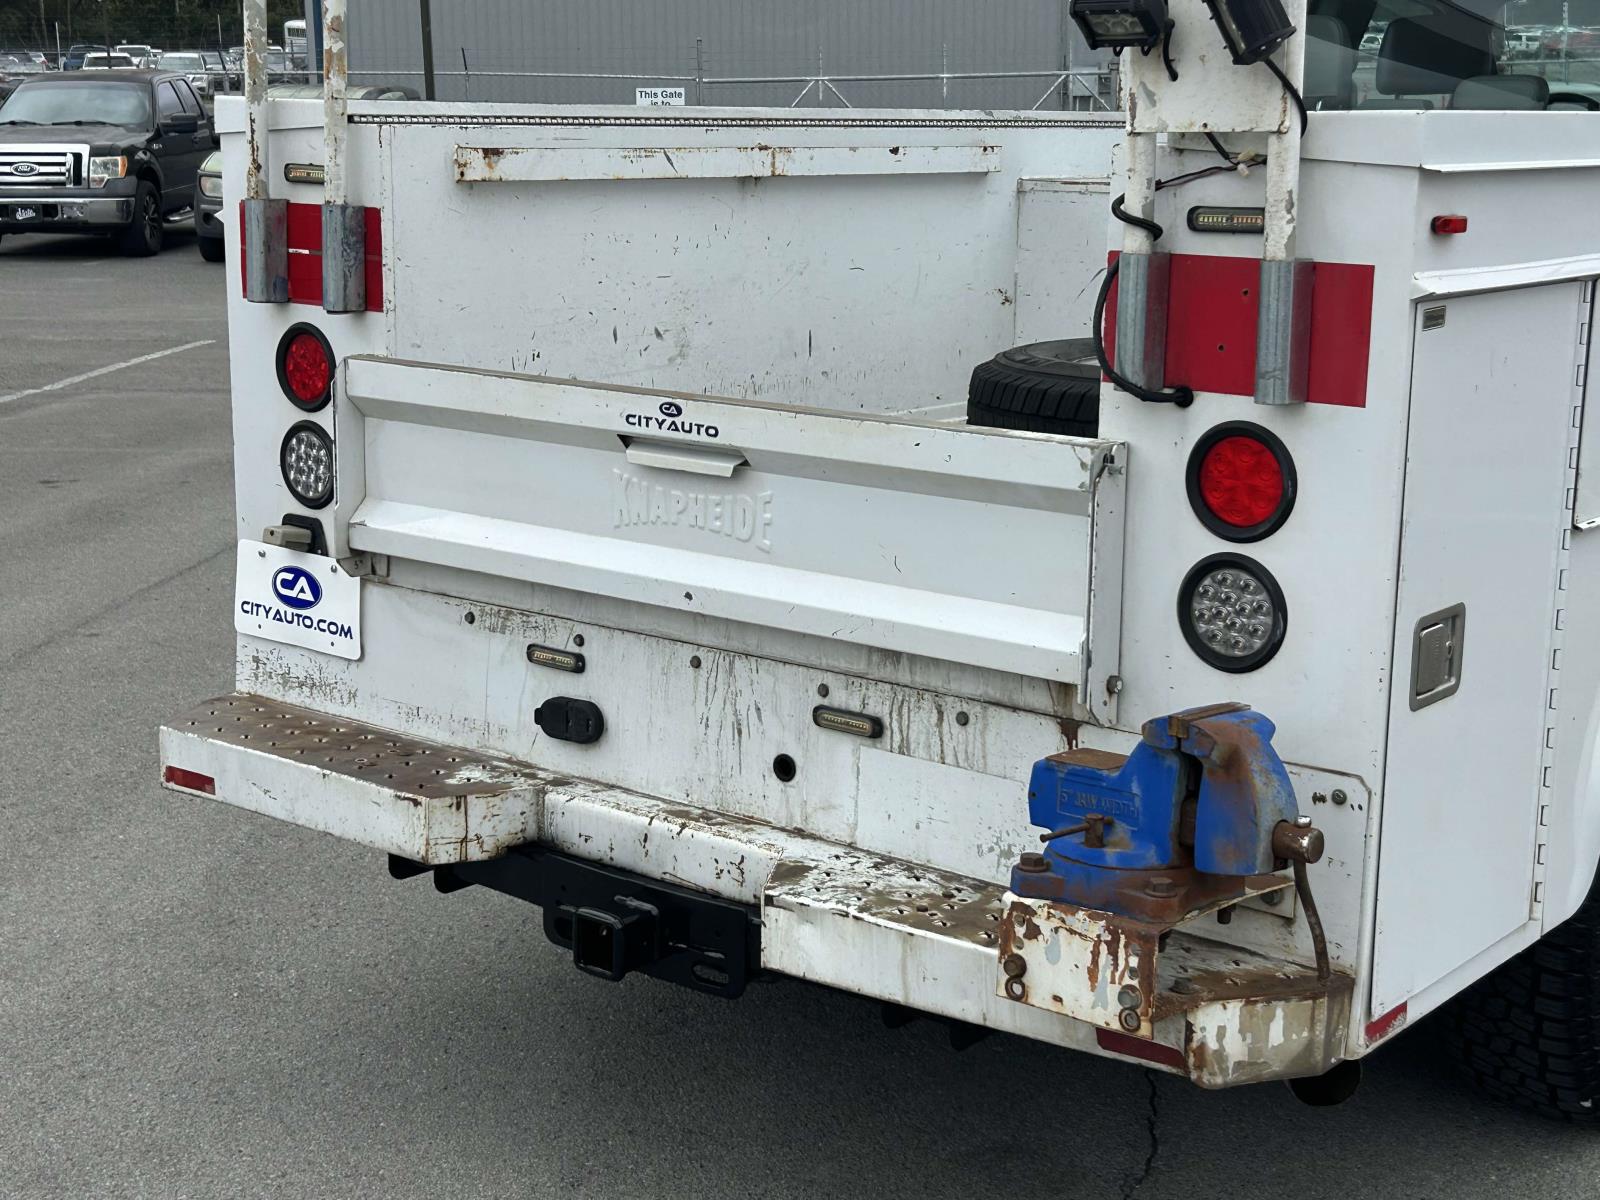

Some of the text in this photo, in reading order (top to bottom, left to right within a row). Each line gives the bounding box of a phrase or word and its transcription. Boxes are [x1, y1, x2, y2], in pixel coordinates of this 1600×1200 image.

[639, 90, 683, 99] This Gate
[240, 600, 354, 640] CITYAUTO.COM
